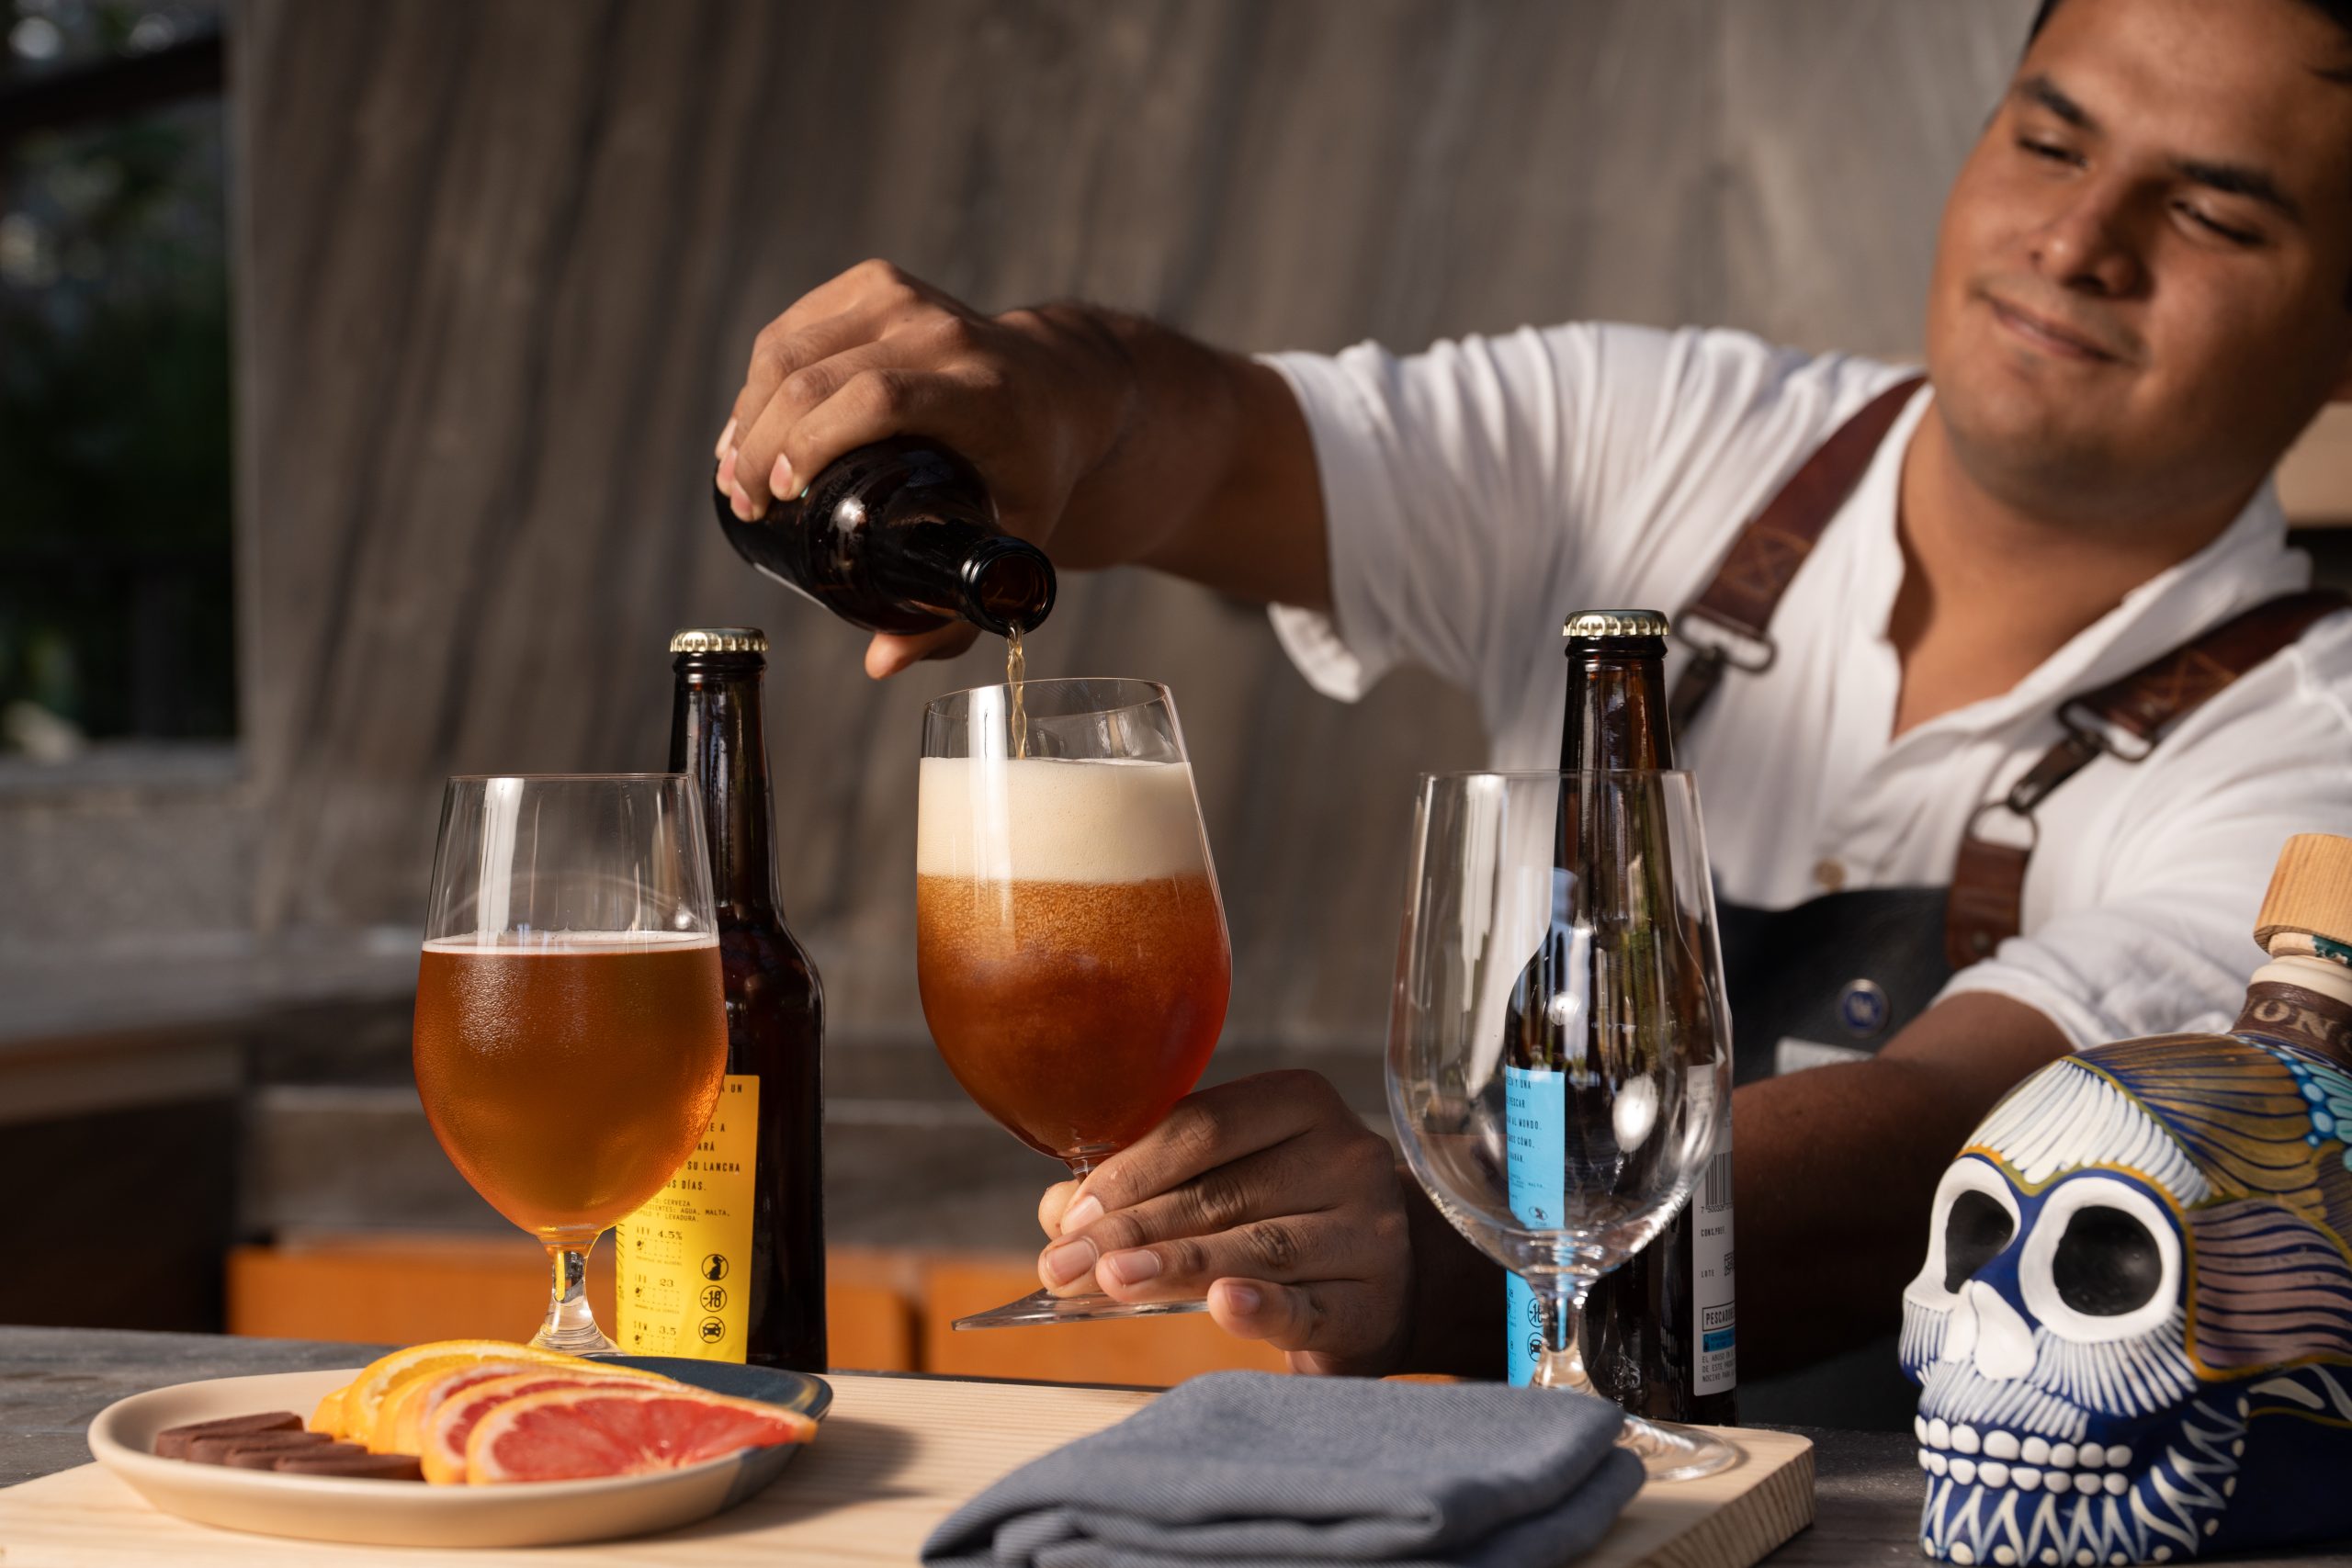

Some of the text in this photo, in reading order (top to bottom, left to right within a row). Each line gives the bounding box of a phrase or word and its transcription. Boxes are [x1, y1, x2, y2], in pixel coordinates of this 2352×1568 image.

[730, 1084, 742, 1093] UN
[687, 1160, 740, 1172] SU LANCHA
[682, 1179, 707, 1191] DÍAS.
[663, 1198, 691, 1207] CERVEZA
[705, 1209, 730, 1217] MALTA,
[657, 1230, 683, 1240] 4.5%
[659, 1278, 673, 1288] 23
[659, 1325, 676, 1336] 3.5
